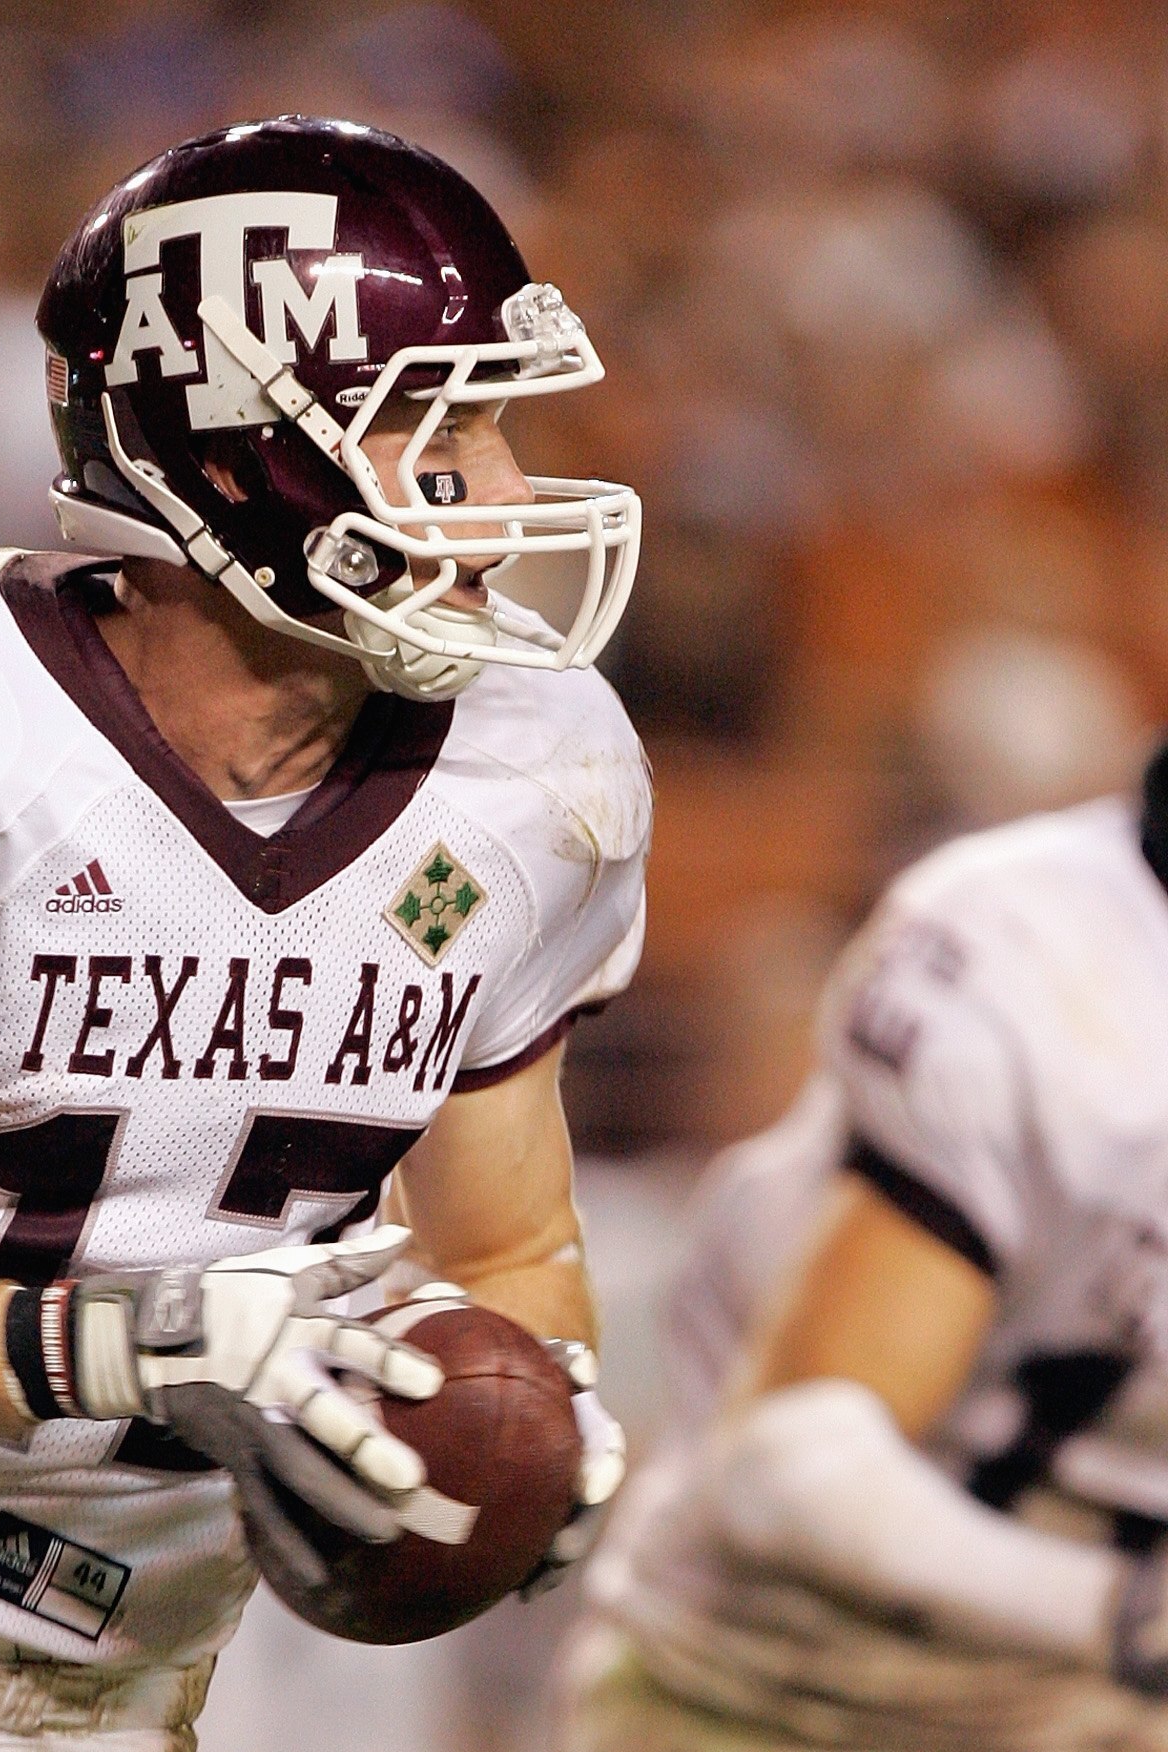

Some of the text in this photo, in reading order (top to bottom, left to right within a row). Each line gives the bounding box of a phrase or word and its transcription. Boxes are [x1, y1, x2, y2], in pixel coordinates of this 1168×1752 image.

[45, 894, 123, 914] adidas
[21, 955, 481, 1092] TEXAS A&M
